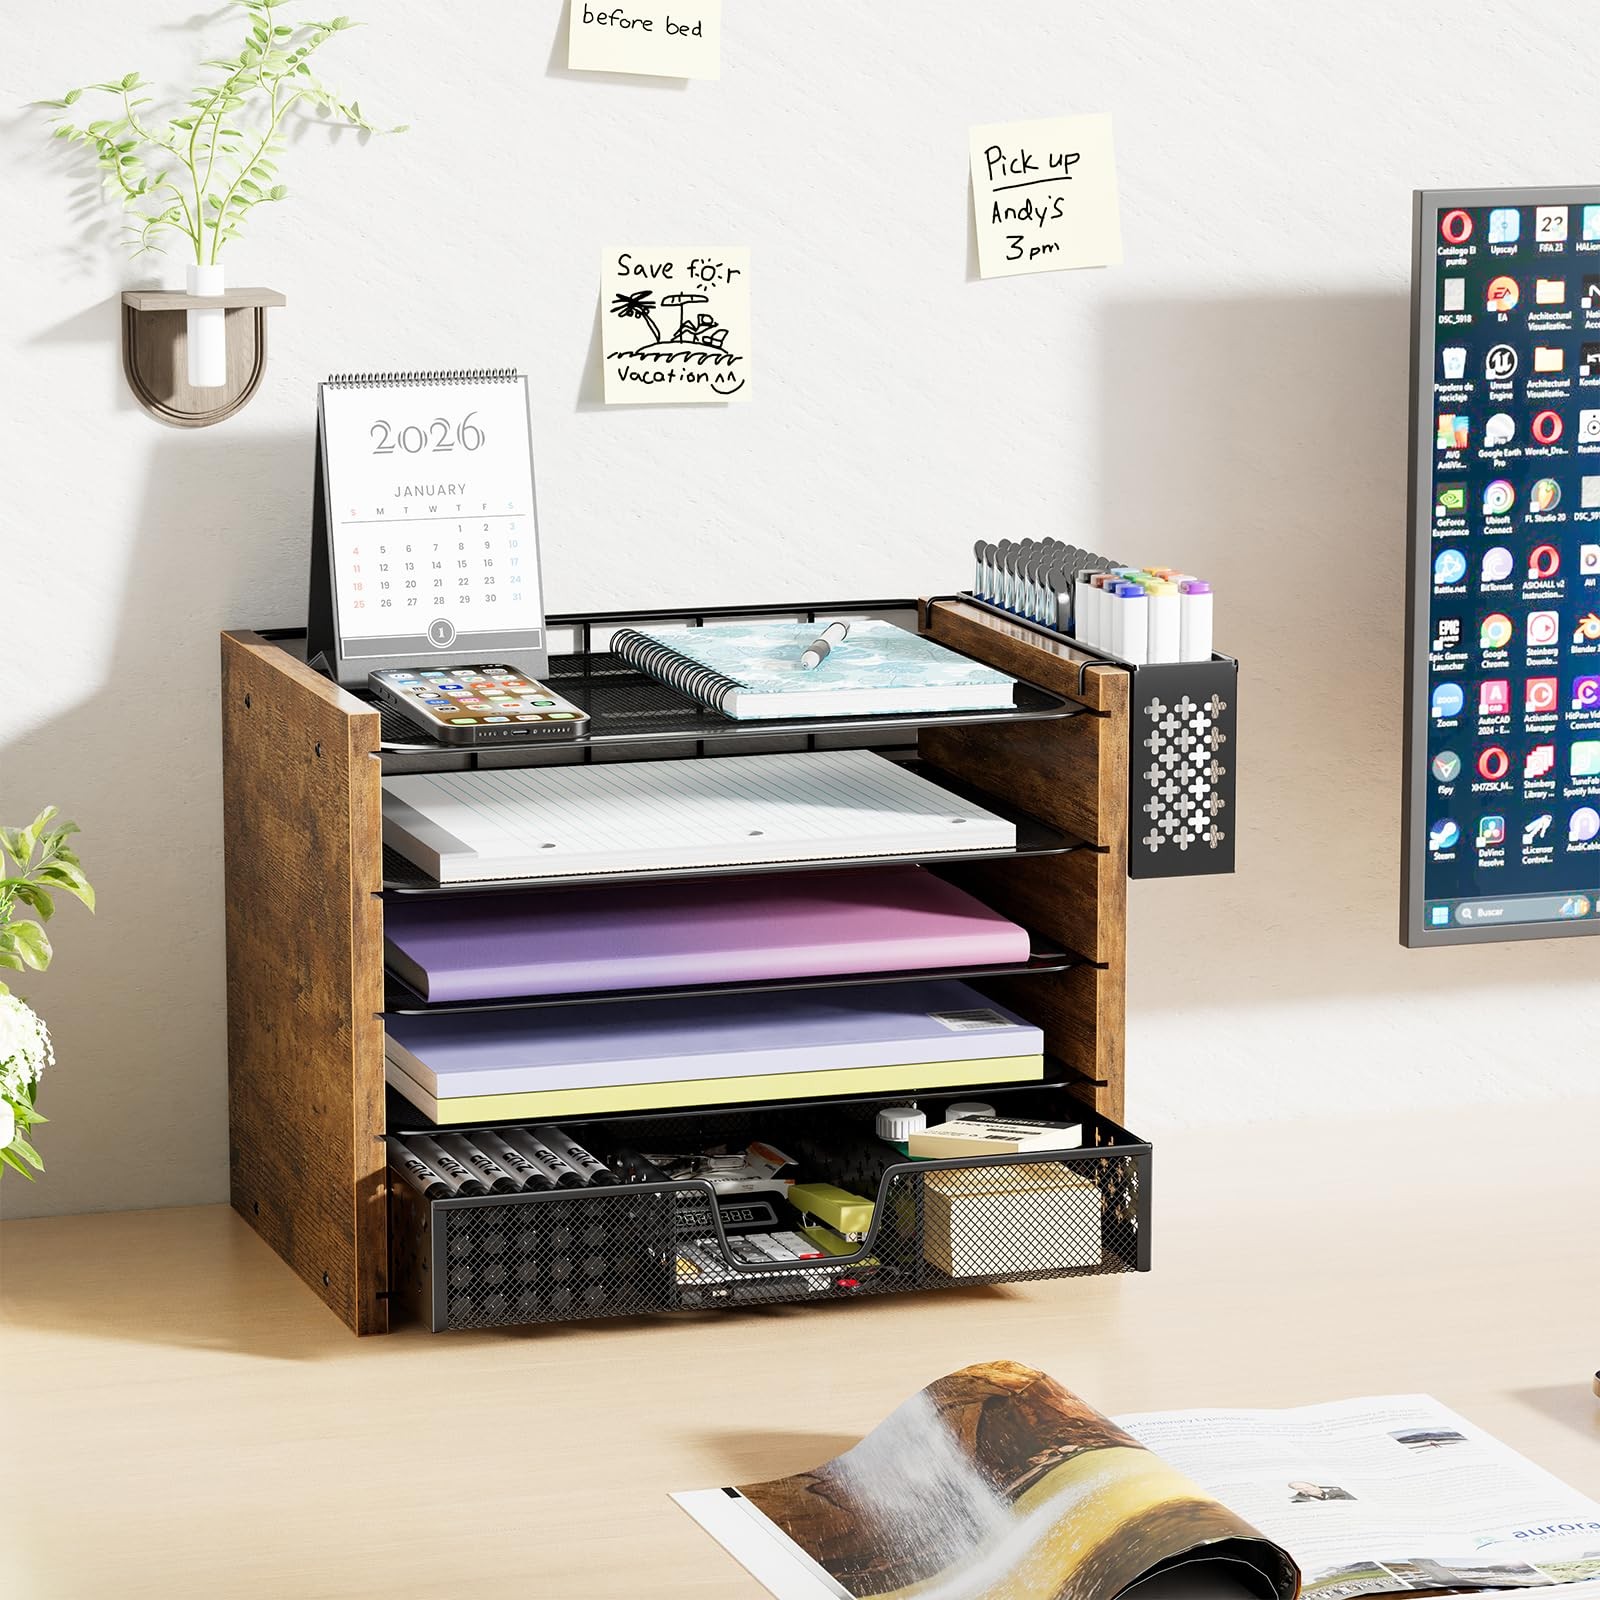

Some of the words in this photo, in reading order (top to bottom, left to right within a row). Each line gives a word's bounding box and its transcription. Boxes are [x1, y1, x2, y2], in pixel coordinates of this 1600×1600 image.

[583, 3, 653, 31] before
[666, 16, 702, 37] bed
[984, 145, 1039, 180] Pick
[1050, 153, 1080, 174] up
[992, 195, 1064, 228] Andy's
[618, 254, 673, 278] Save
[687, 258, 741, 283] for
[1490, 381, 1512, 390] Unreal
[1490, 392, 1513, 401] Engine
[370, 411, 485, 454] 2026
[1478, 450, 1503, 458] Google
[394, 483, 466, 498] JANUARY
[1558, 513, 1566, 521] 20
[509, 540, 518, 548] 10
[510, 558, 518, 566] 17
[1439, 619, 1459, 635] EPIC
[1483, 650, 1508, 658] Google
[1434, 852, 1455, 860] Steam
[1512, 1522, 1600, 1538] aurora
